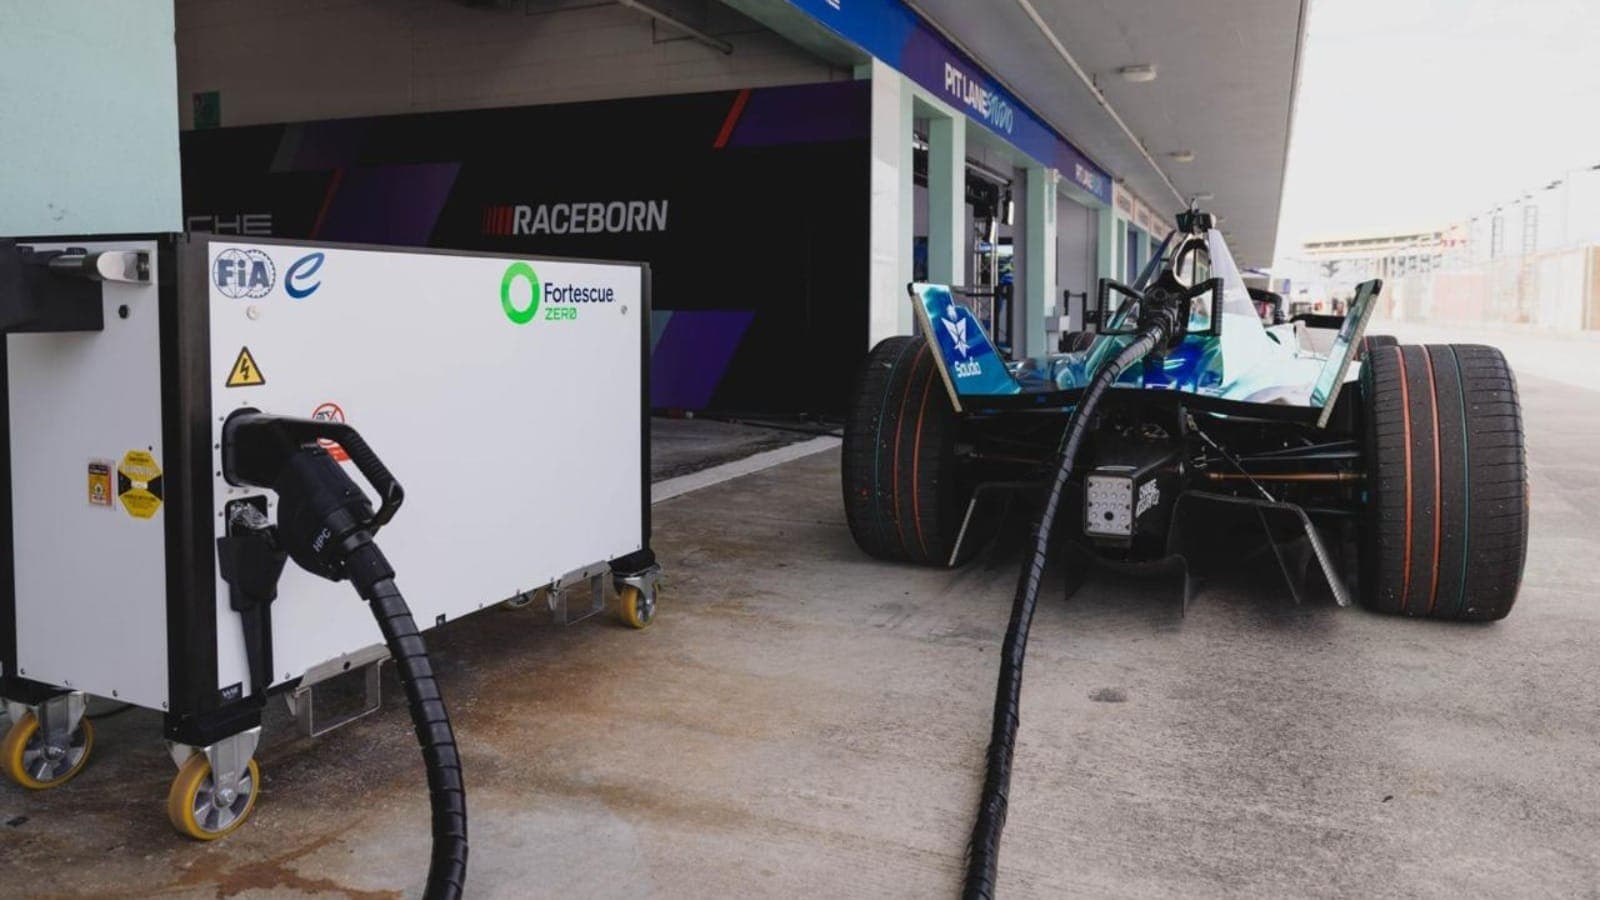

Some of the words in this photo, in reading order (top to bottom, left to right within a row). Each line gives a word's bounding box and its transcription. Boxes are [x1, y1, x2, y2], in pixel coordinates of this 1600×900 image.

[945, 62, 962, 98] PIT
[963, 75, 988, 119] LANE
[513, 200, 668, 235] RACEBORN
[544, 283, 614, 303] Fortescue
